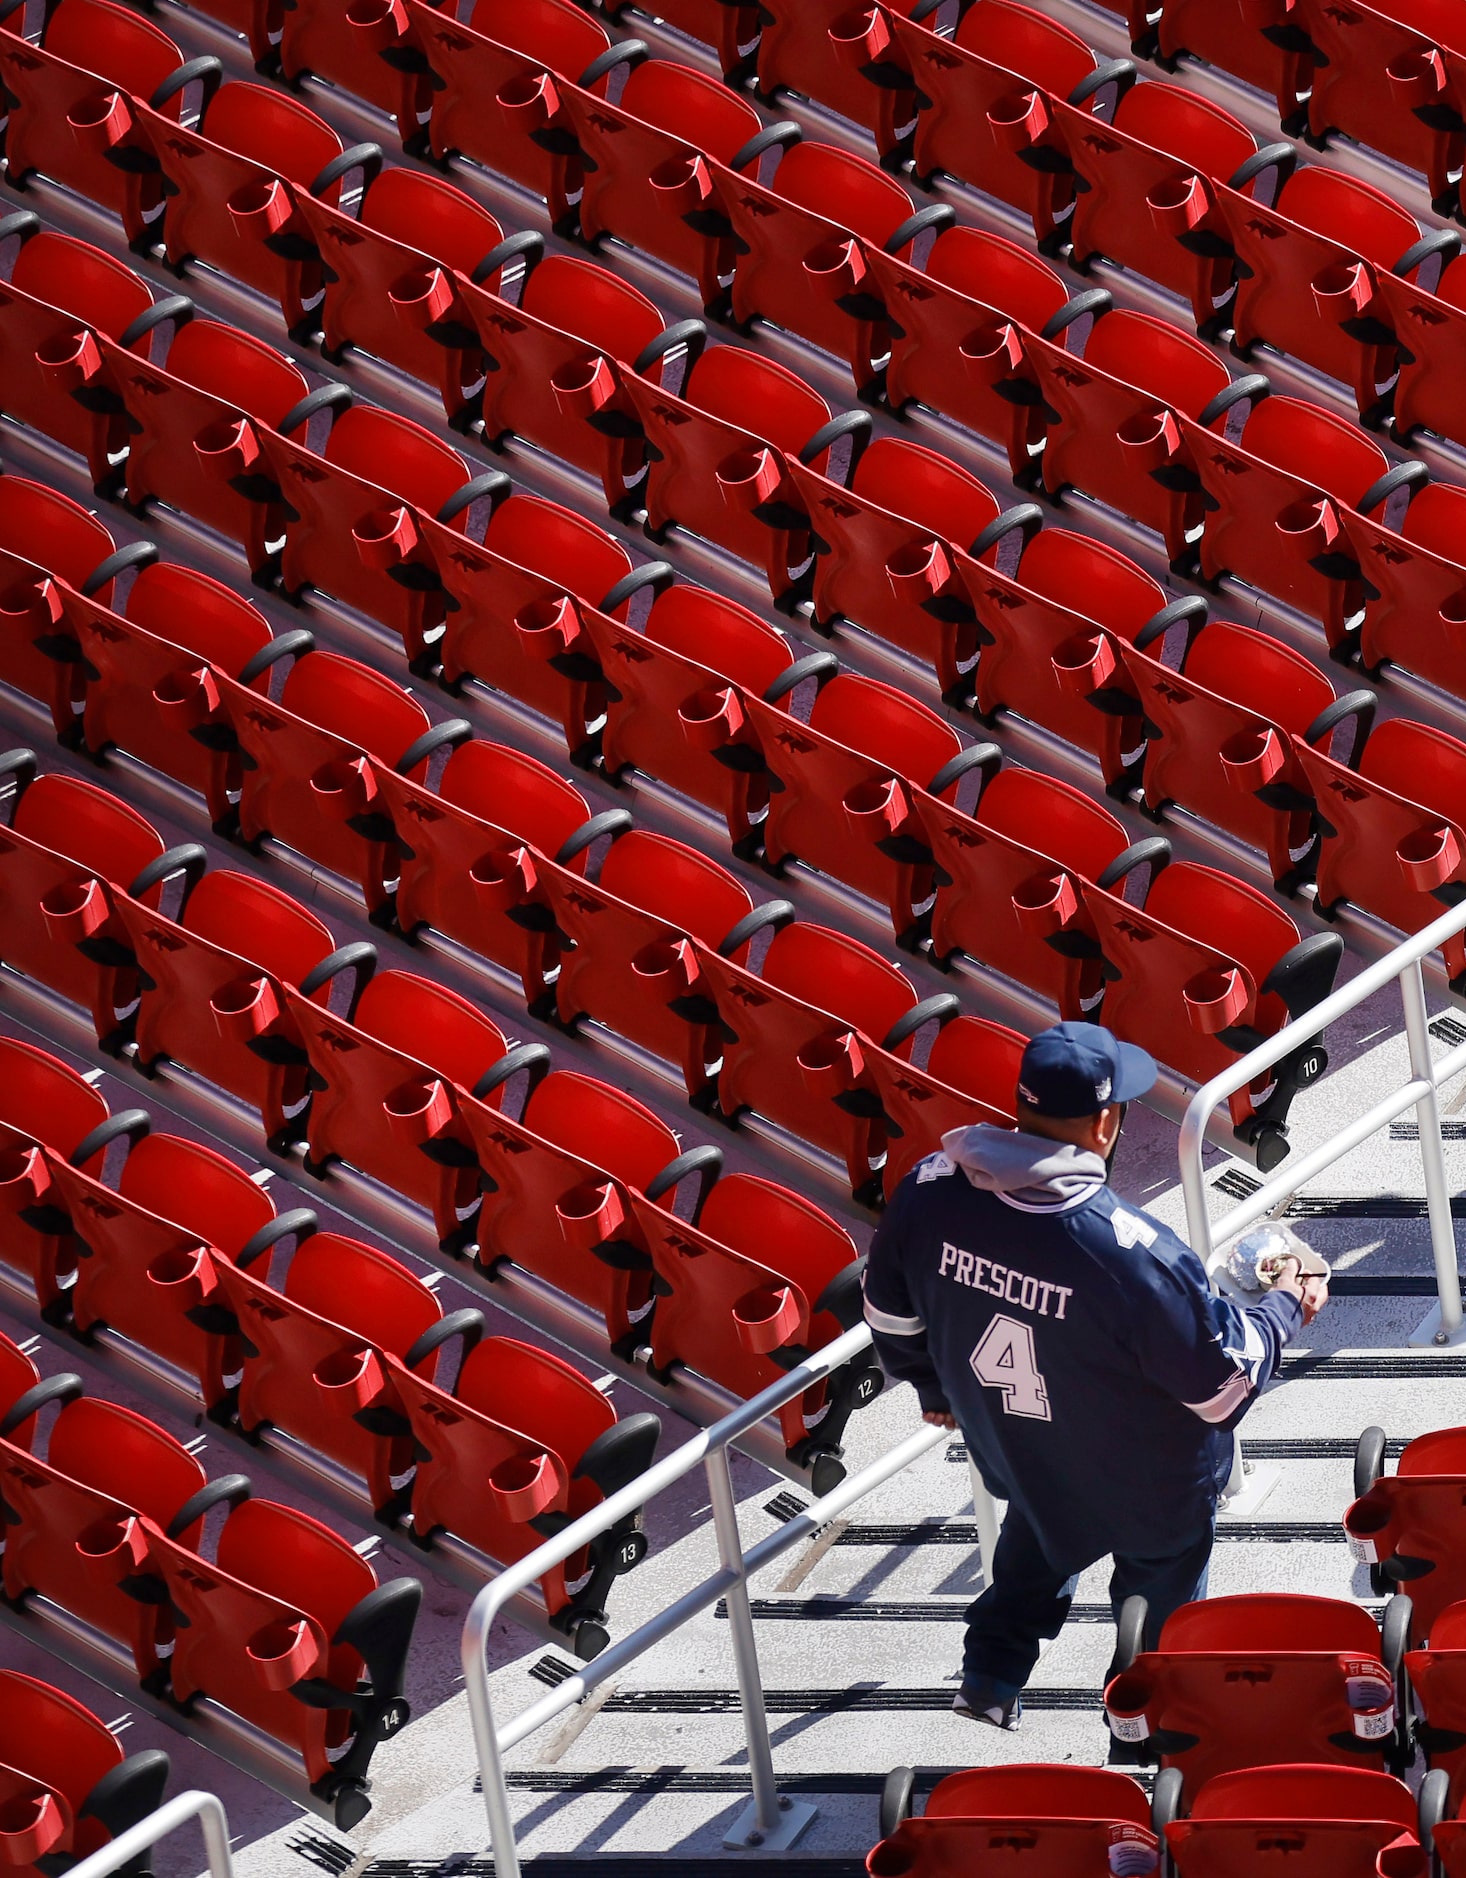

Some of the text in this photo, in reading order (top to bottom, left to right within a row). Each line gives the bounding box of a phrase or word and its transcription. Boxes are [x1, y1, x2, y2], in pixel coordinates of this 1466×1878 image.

[1303, 1057, 1318, 1077] 10
[1109, 1207, 1159, 1250] 4
[937, 1241, 1073, 1321] PRESCOTT
[969, 1312, 1052, 1423] 4
[857, 1379, 874, 1399] 12
[620, 1543, 636, 1564] 13
[381, 1709, 400, 1730] 14
